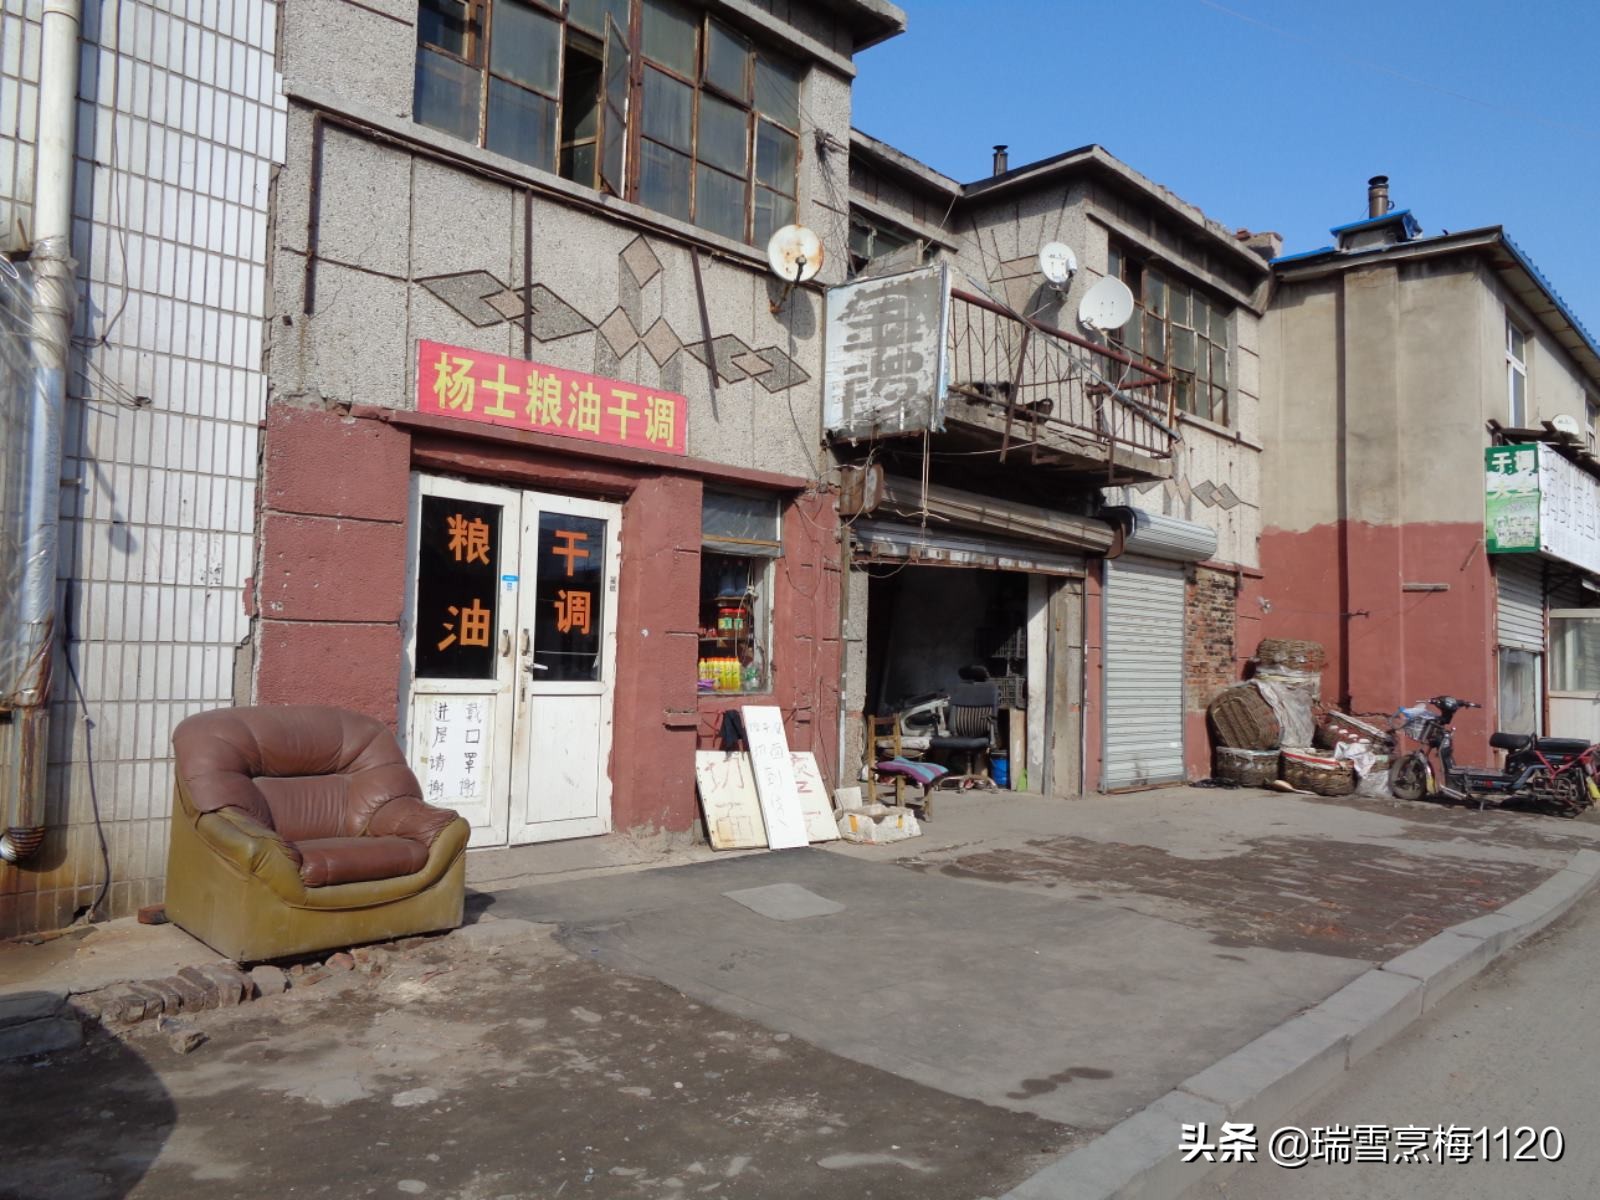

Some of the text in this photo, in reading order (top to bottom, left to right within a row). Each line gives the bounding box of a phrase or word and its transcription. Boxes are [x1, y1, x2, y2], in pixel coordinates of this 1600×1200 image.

[433, 352, 675, 448] 杨士粮油干调
[438, 513, 490, 652] 粮油
[552, 530, 591, 636] 干调
